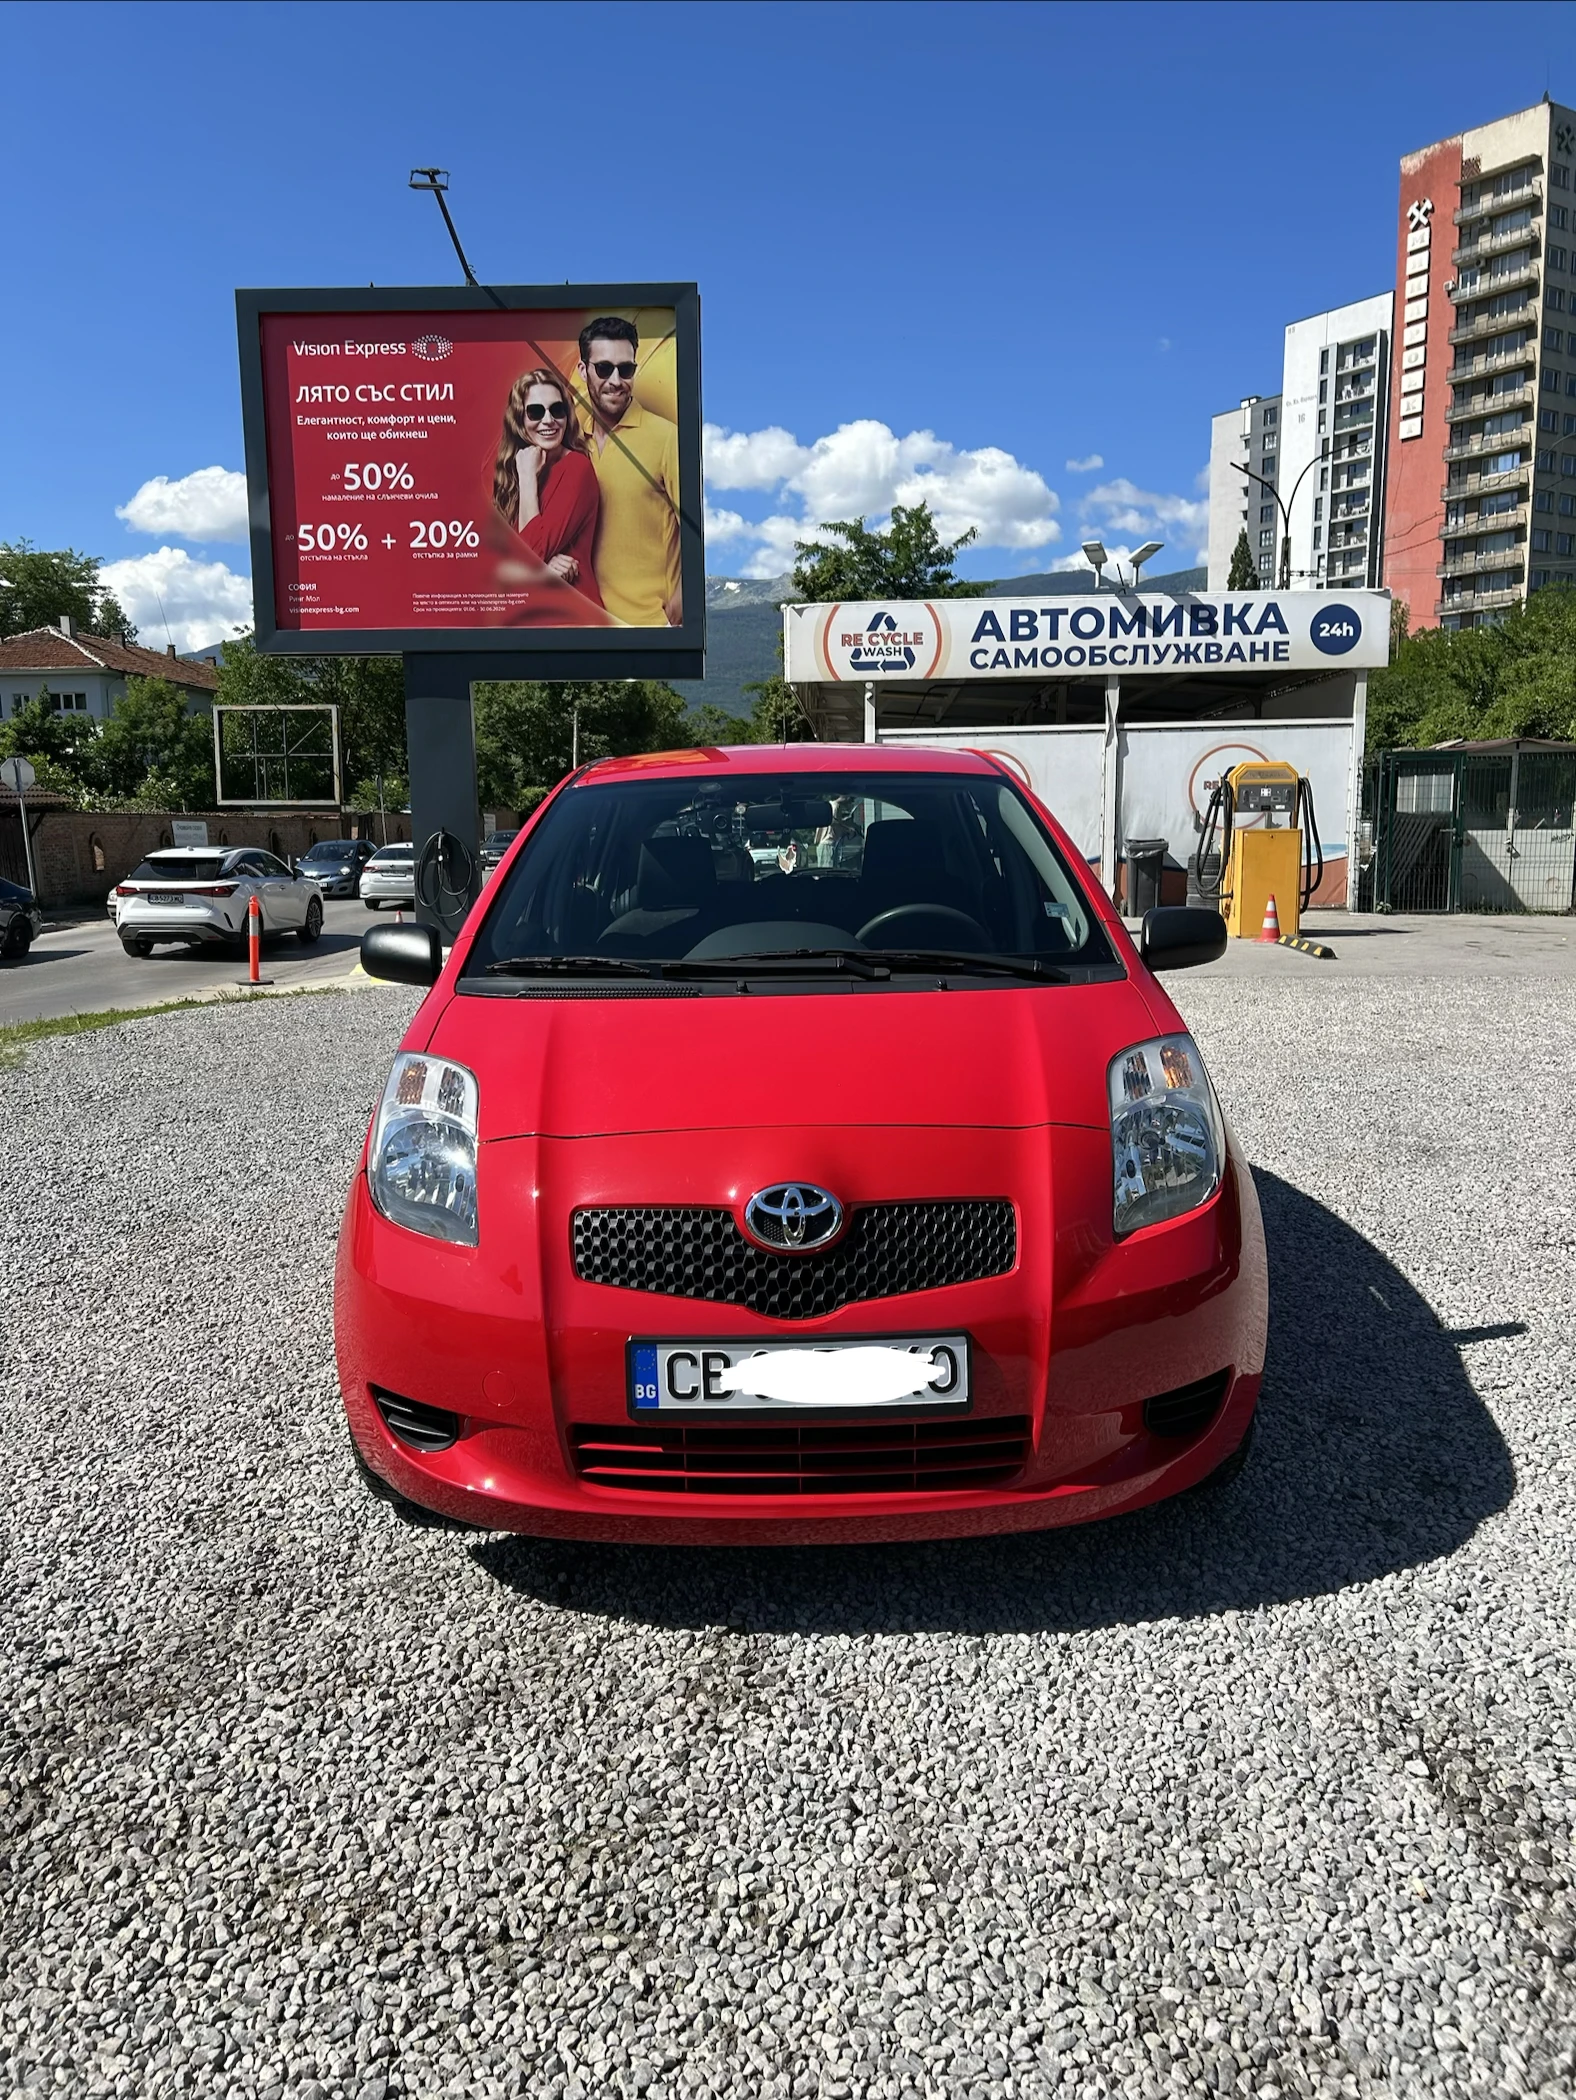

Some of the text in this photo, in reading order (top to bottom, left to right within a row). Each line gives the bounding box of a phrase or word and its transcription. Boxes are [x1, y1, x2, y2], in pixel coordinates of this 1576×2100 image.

[293, 340, 406, 358] Vision Express
[296, 383, 454, 403] ЛЯТО СЪС СТИЛ
[297, 413, 457, 427] Елегантност, комфорт и цени,
[326, 429, 428, 441] които ще обикнеш
[330, 462, 415, 491] до 50%
[322, 492, 439, 502] намаление на слънчеви очила
[285, 520, 480, 551] до 50% + 20%
[300, 553, 369, 562] отстъпка на стъкла
[413, 551, 478, 560] отстъпка за рамки
[288, 583, 317, 591] СОФИЯ
[289, 606, 360, 615] visionexpress-bg.com
[971, 602, 1290, 643] АВТОМИВКА
[1319, 621, 1354, 638] 24h
[841, 632, 924, 647] RE CYCLE
[863, 646, 902, 657] WASH
[969, 640, 1290, 670] САМООБСЛУЖВАНЕ
[634, 1383, 657, 1399] BG
